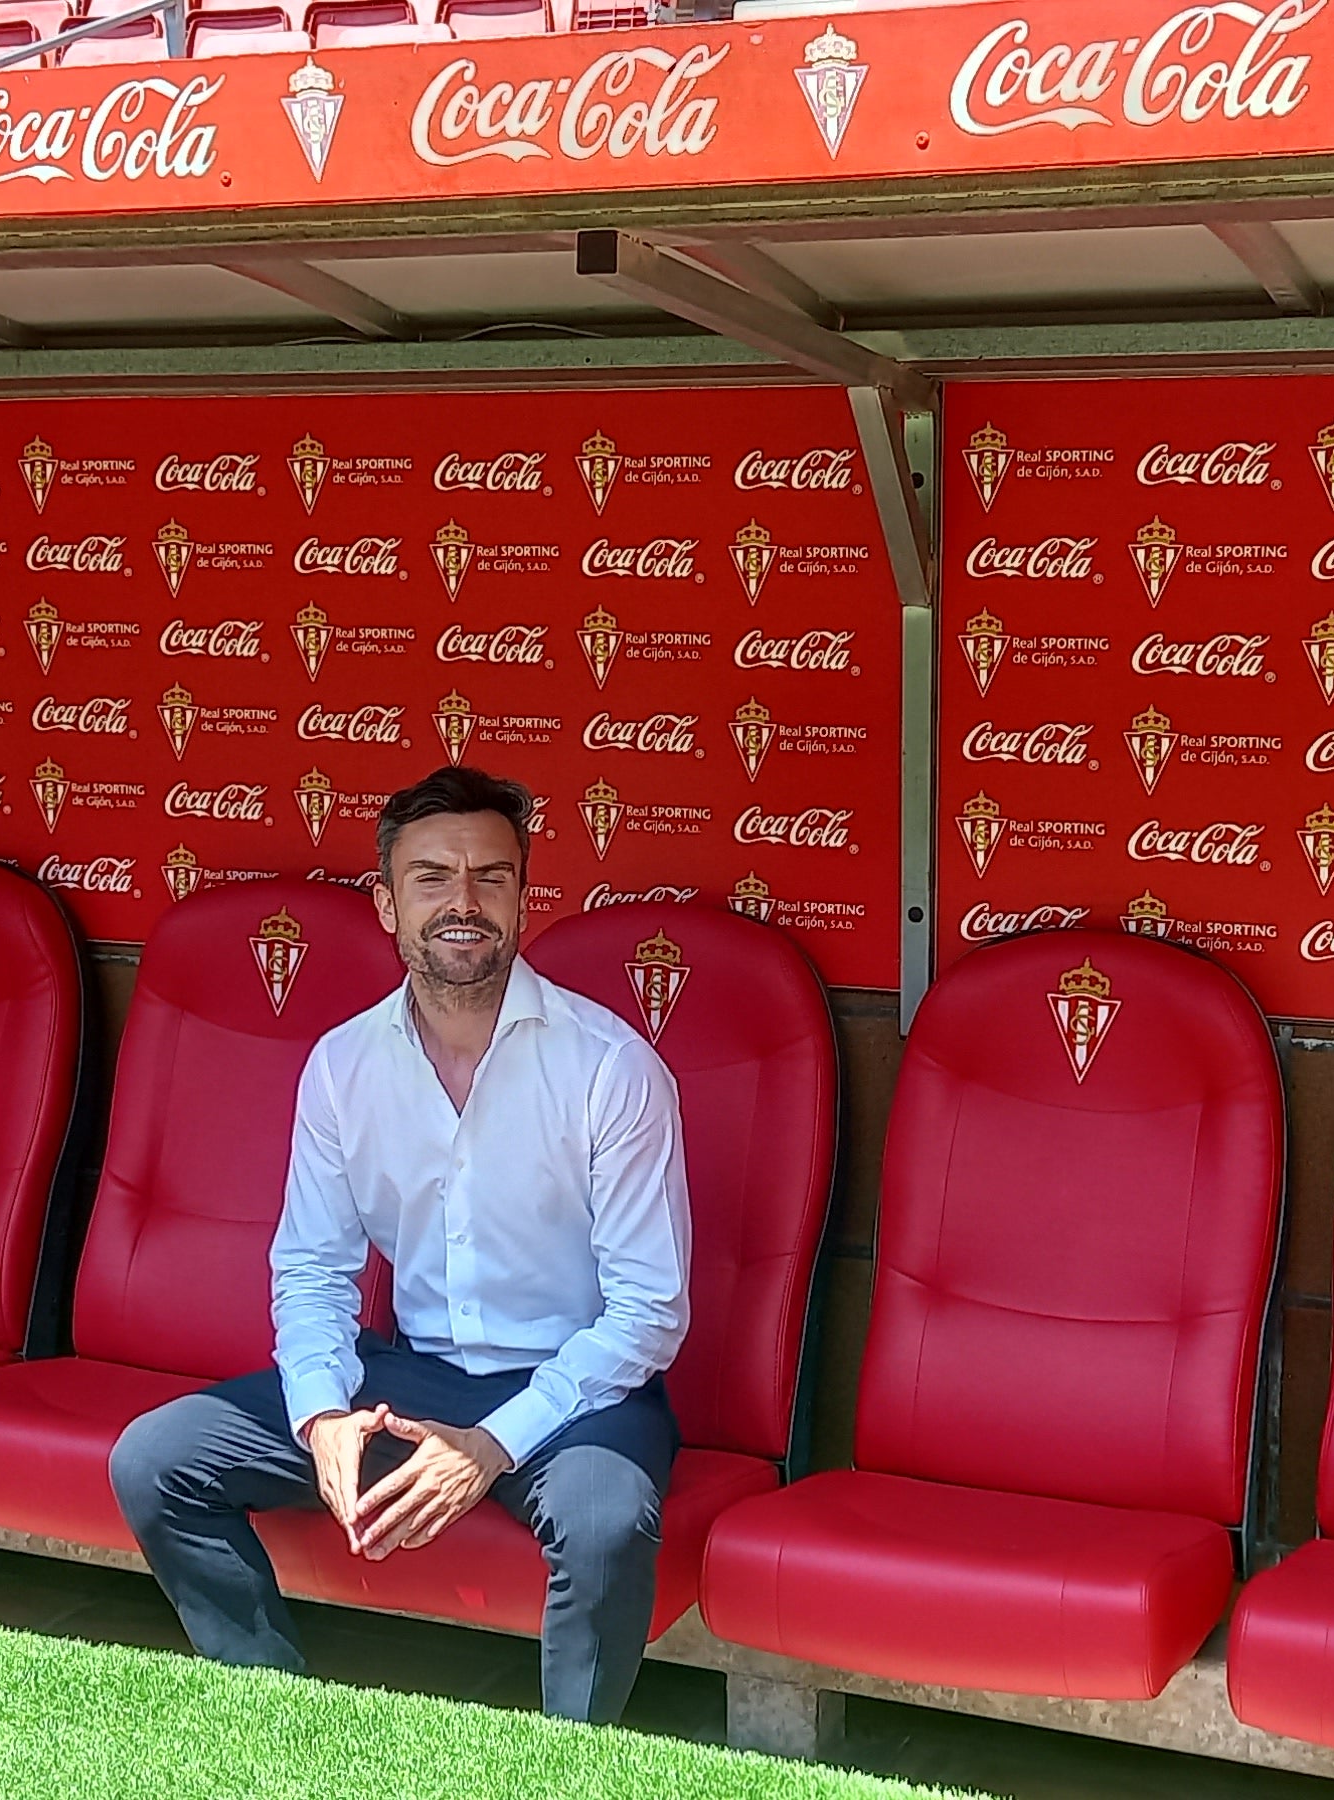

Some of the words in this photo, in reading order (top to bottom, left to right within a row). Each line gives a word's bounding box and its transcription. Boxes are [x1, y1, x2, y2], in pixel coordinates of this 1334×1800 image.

[949, 0, 1328, 137] Coca-Cola
[409, 41, 730, 165] Coca-Cola
[332, 459, 352, 469] Real
[356, 459, 412, 469] SPORTING
[434, 453, 546, 491] Coca-Cola
[623, 456, 646, 468] Real
[650, 456, 710, 468] SPORTING
[734, 449, 857, 491] Coca-Cola
[1017, 450, 1041, 462] Real
[1045, 446, 1113, 462] SPORTING
[1017, 466, 1032, 477] de
[1137, 443, 1276, 485] Coca-Cola
[156, 455, 260, 491] Coca-Cola
[333, 473, 345, 483] de
[625, 471, 639, 482] de
[26, 536, 127, 571] Coca-Cola
[294, 538, 402, 574] Coca-Cola
[476, 545, 498, 556] Real
[501, 546, 559, 556] SPORTING
[478, 559, 490, 570] de
[582, 539, 699, 577] Coca-Cola
[778, 546, 802, 558] Real
[806, 547, 868, 558] SPORTING
[780, 561, 794, 572] de
[966, 538, 1098, 578] Coca-Cola
[160, 620, 263, 657] Coca-Cola
[437, 625, 548, 663] Coca-Cola
[624, 632, 647, 644] Real
[651, 633, 710, 645] SPORTING
[626, 647, 640, 658] de
[734, 630, 855, 670] Coca-Cola
[1132, 634, 1270, 676] Coca-Cola
[32, 697, 131, 733] Coca-Cola
[298, 704, 405, 742] Coca-Cola
[479, 716, 500, 727] Real
[503, 717, 560, 729] SPORTING
[583, 713, 698, 752] Coca-Cola
[778, 725, 801, 736] Real
[805, 726, 866, 738] SPORTING
[480, 730, 492, 740] de
[780, 739, 793, 750] de
[963, 722, 1093, 763] Coca-Cola
[1179, 735, 1206, 746] Real
[1210, 736, 1281, 749] SPORTING
[1181, 750, 1196, 762] de
[165, 782, 267, 820] Coca-Cola
[734, 806, 853, 847] Coca-Cola
[1128, 821, 1265, 864] Coca-Cola
[37, 855, 136, 892] Coca-Cola
